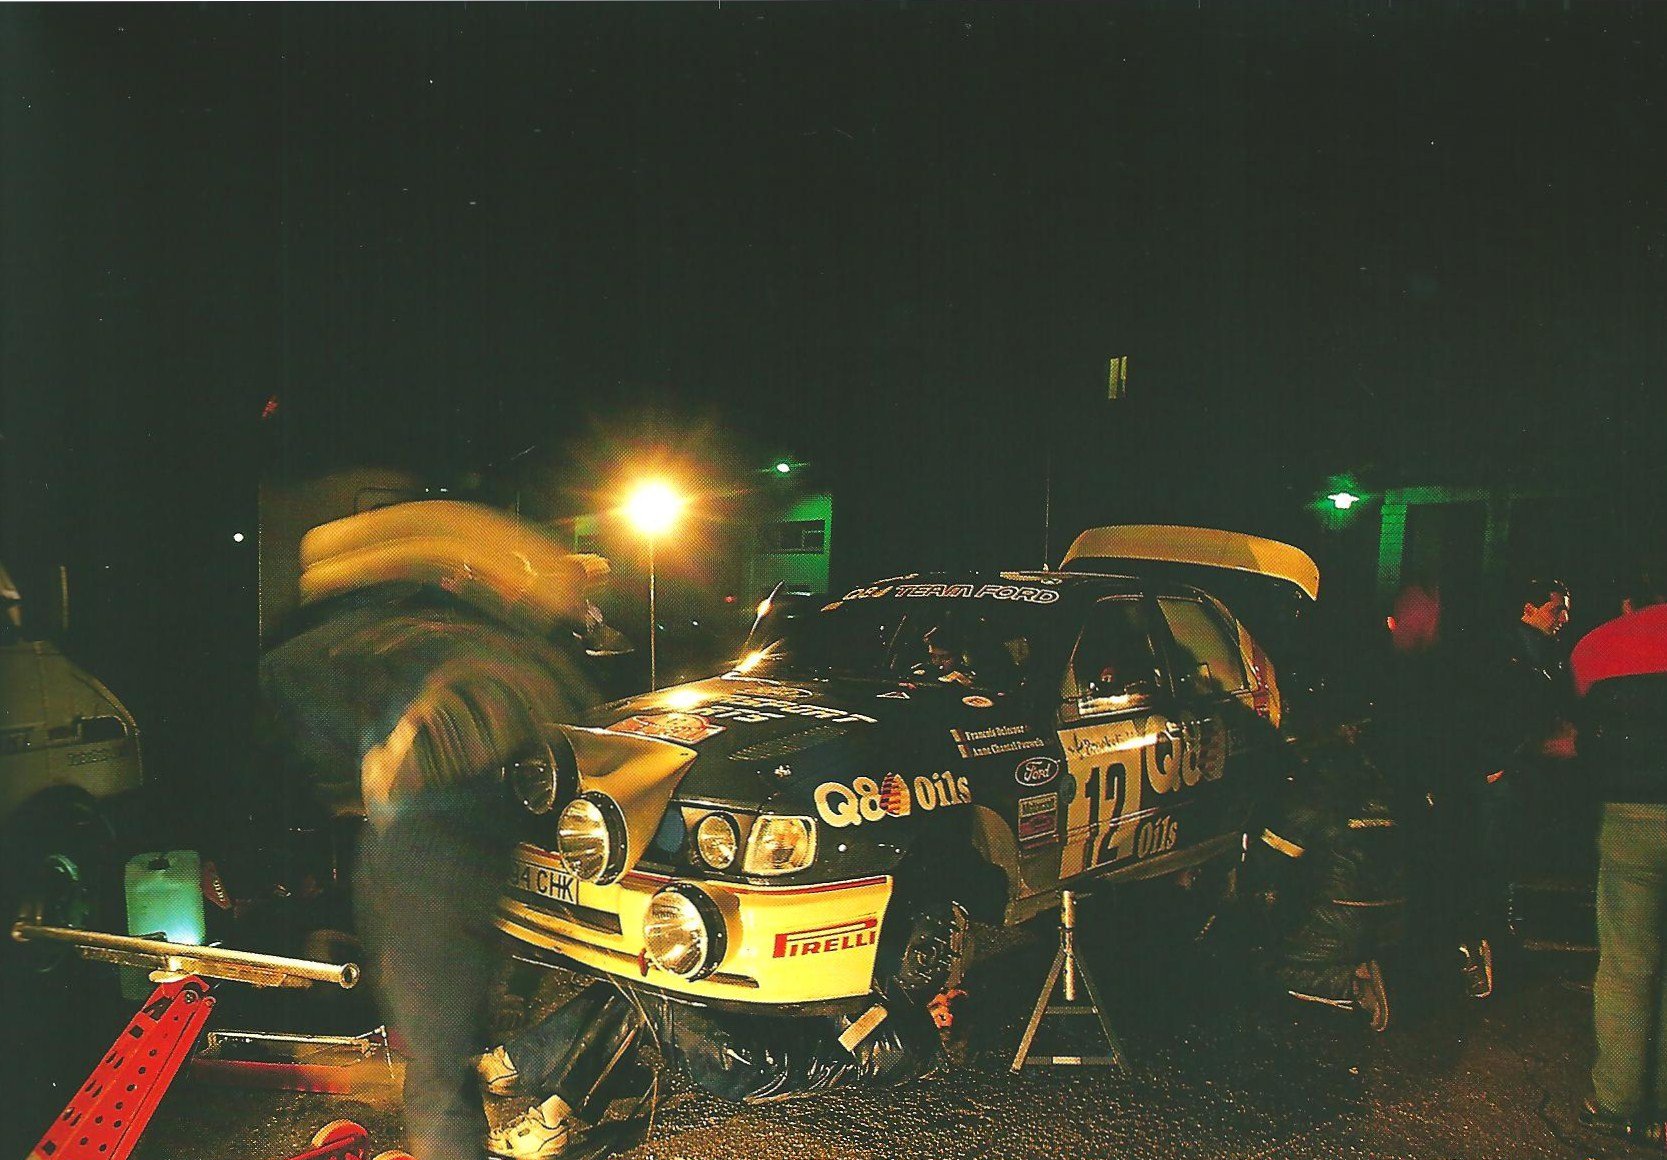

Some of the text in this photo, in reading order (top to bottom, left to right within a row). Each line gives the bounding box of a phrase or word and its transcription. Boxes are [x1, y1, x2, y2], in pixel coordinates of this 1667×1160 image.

[895, 583, 973, 598] TEAM
[974, 584, 1060, 604] FORD
[1023, 761, 1051, 782] Ford
[814, 771, 972, 828] Q8 Oils
[1085, 763, 1126, 870] 12
[1138, 815, 1178, 858] Oils
[538, 869, 574, 902] CHK
[773, 918, 877, 958] PIRELLI
